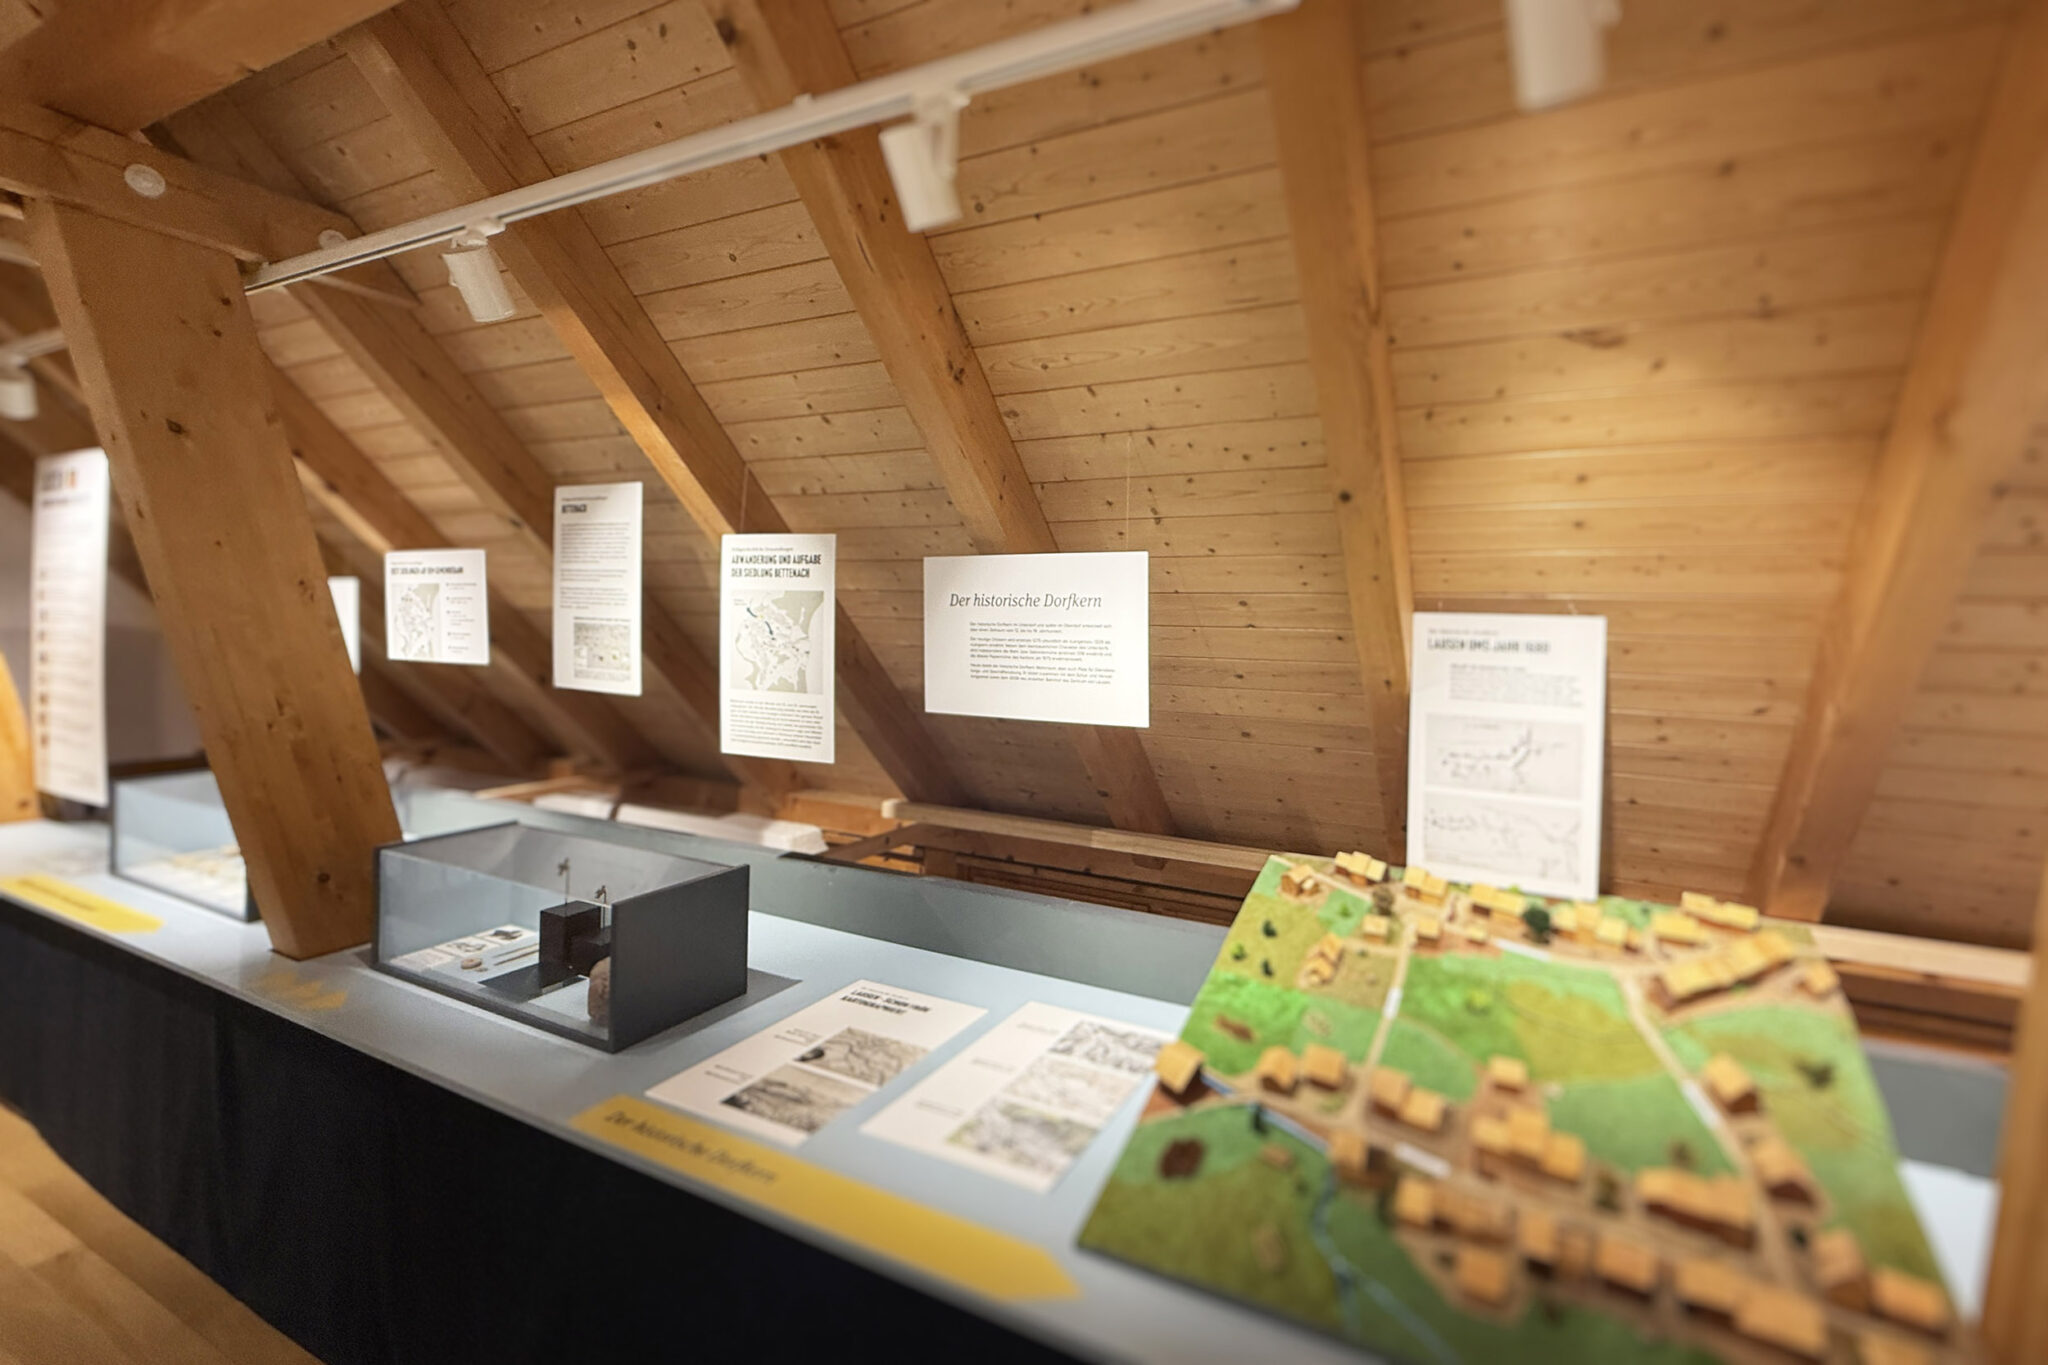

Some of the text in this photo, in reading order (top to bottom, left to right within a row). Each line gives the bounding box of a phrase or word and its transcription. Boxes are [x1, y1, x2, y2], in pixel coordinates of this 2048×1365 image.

[778, 554, 791, 565] UND
[792, 553, 822, 565] AUFGABE
[950, 592, 1102, 610] Der historische Dorfkern
